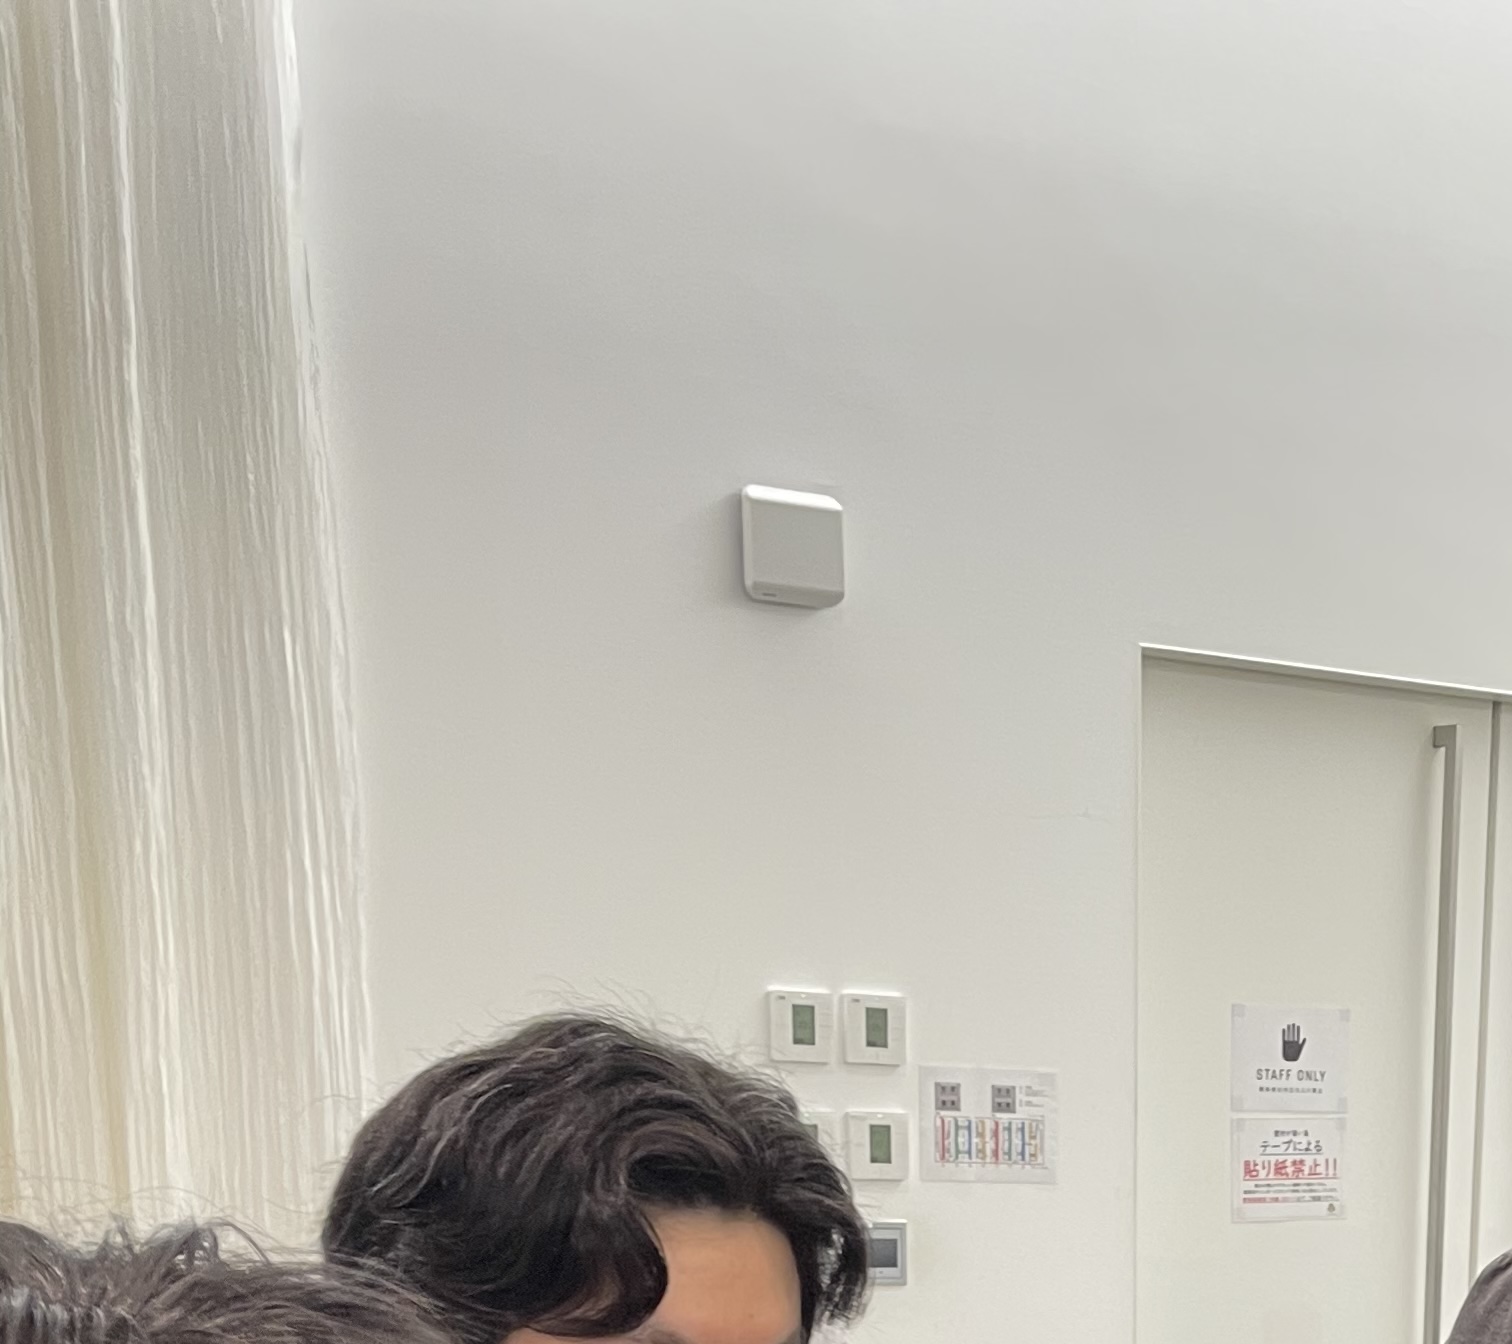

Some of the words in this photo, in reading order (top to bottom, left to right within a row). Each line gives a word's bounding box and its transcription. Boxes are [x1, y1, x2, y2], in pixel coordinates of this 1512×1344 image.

[1256, 1068, 1292, 1081] STAFF
[1297, 1069, 1327, 1082] ONLY
[1260, 1138, 1323, 1153] テープによる
